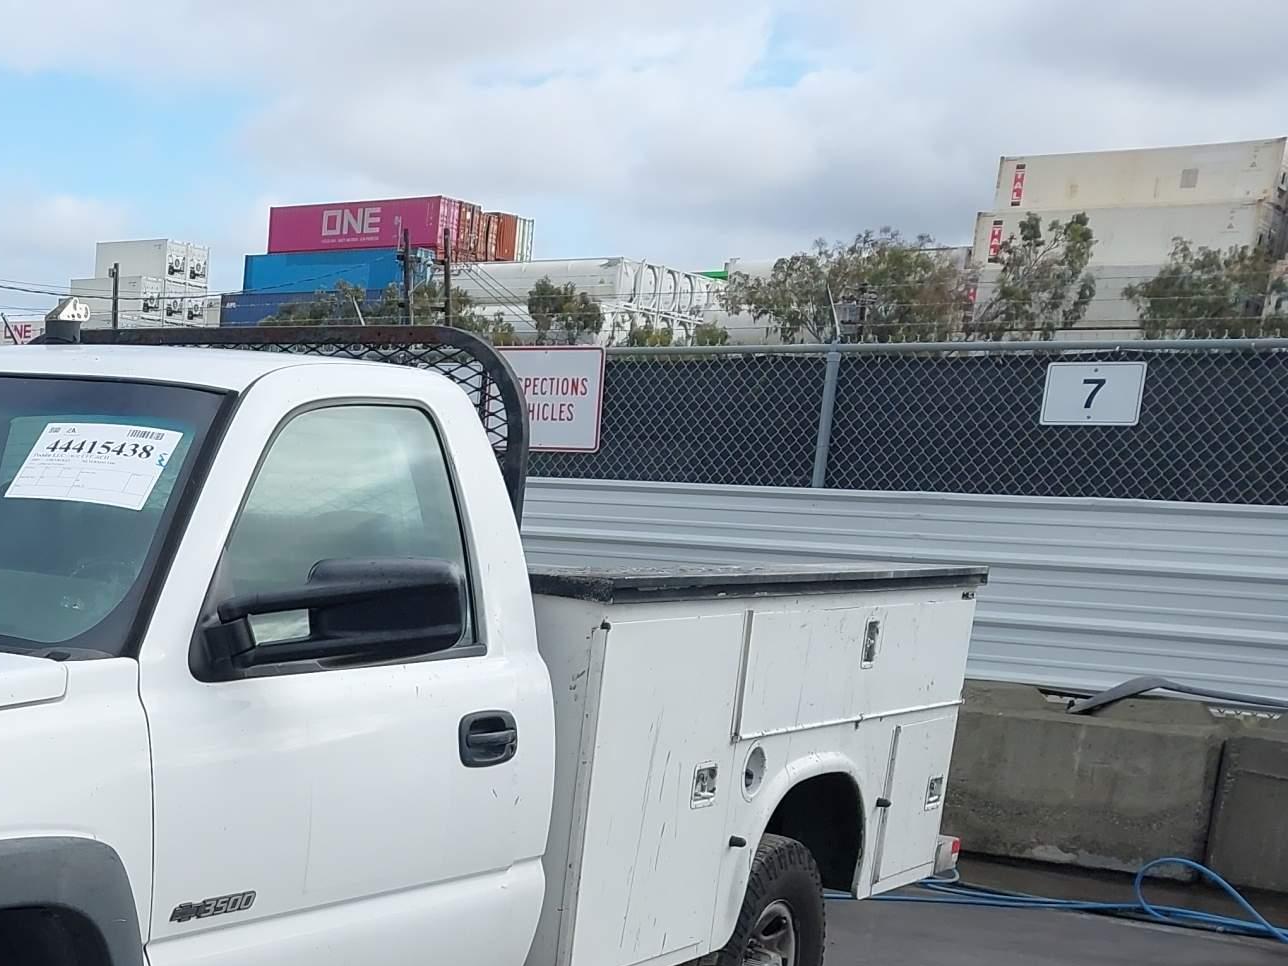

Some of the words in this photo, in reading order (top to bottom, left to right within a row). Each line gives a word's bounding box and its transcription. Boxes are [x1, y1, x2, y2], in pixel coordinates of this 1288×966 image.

[322, 207, 381, 236] ONE
[1083, 378, 1106, 409] 7
[46, 439, 154, 460] 44415438
[200, 893, 255, 917] 3500
